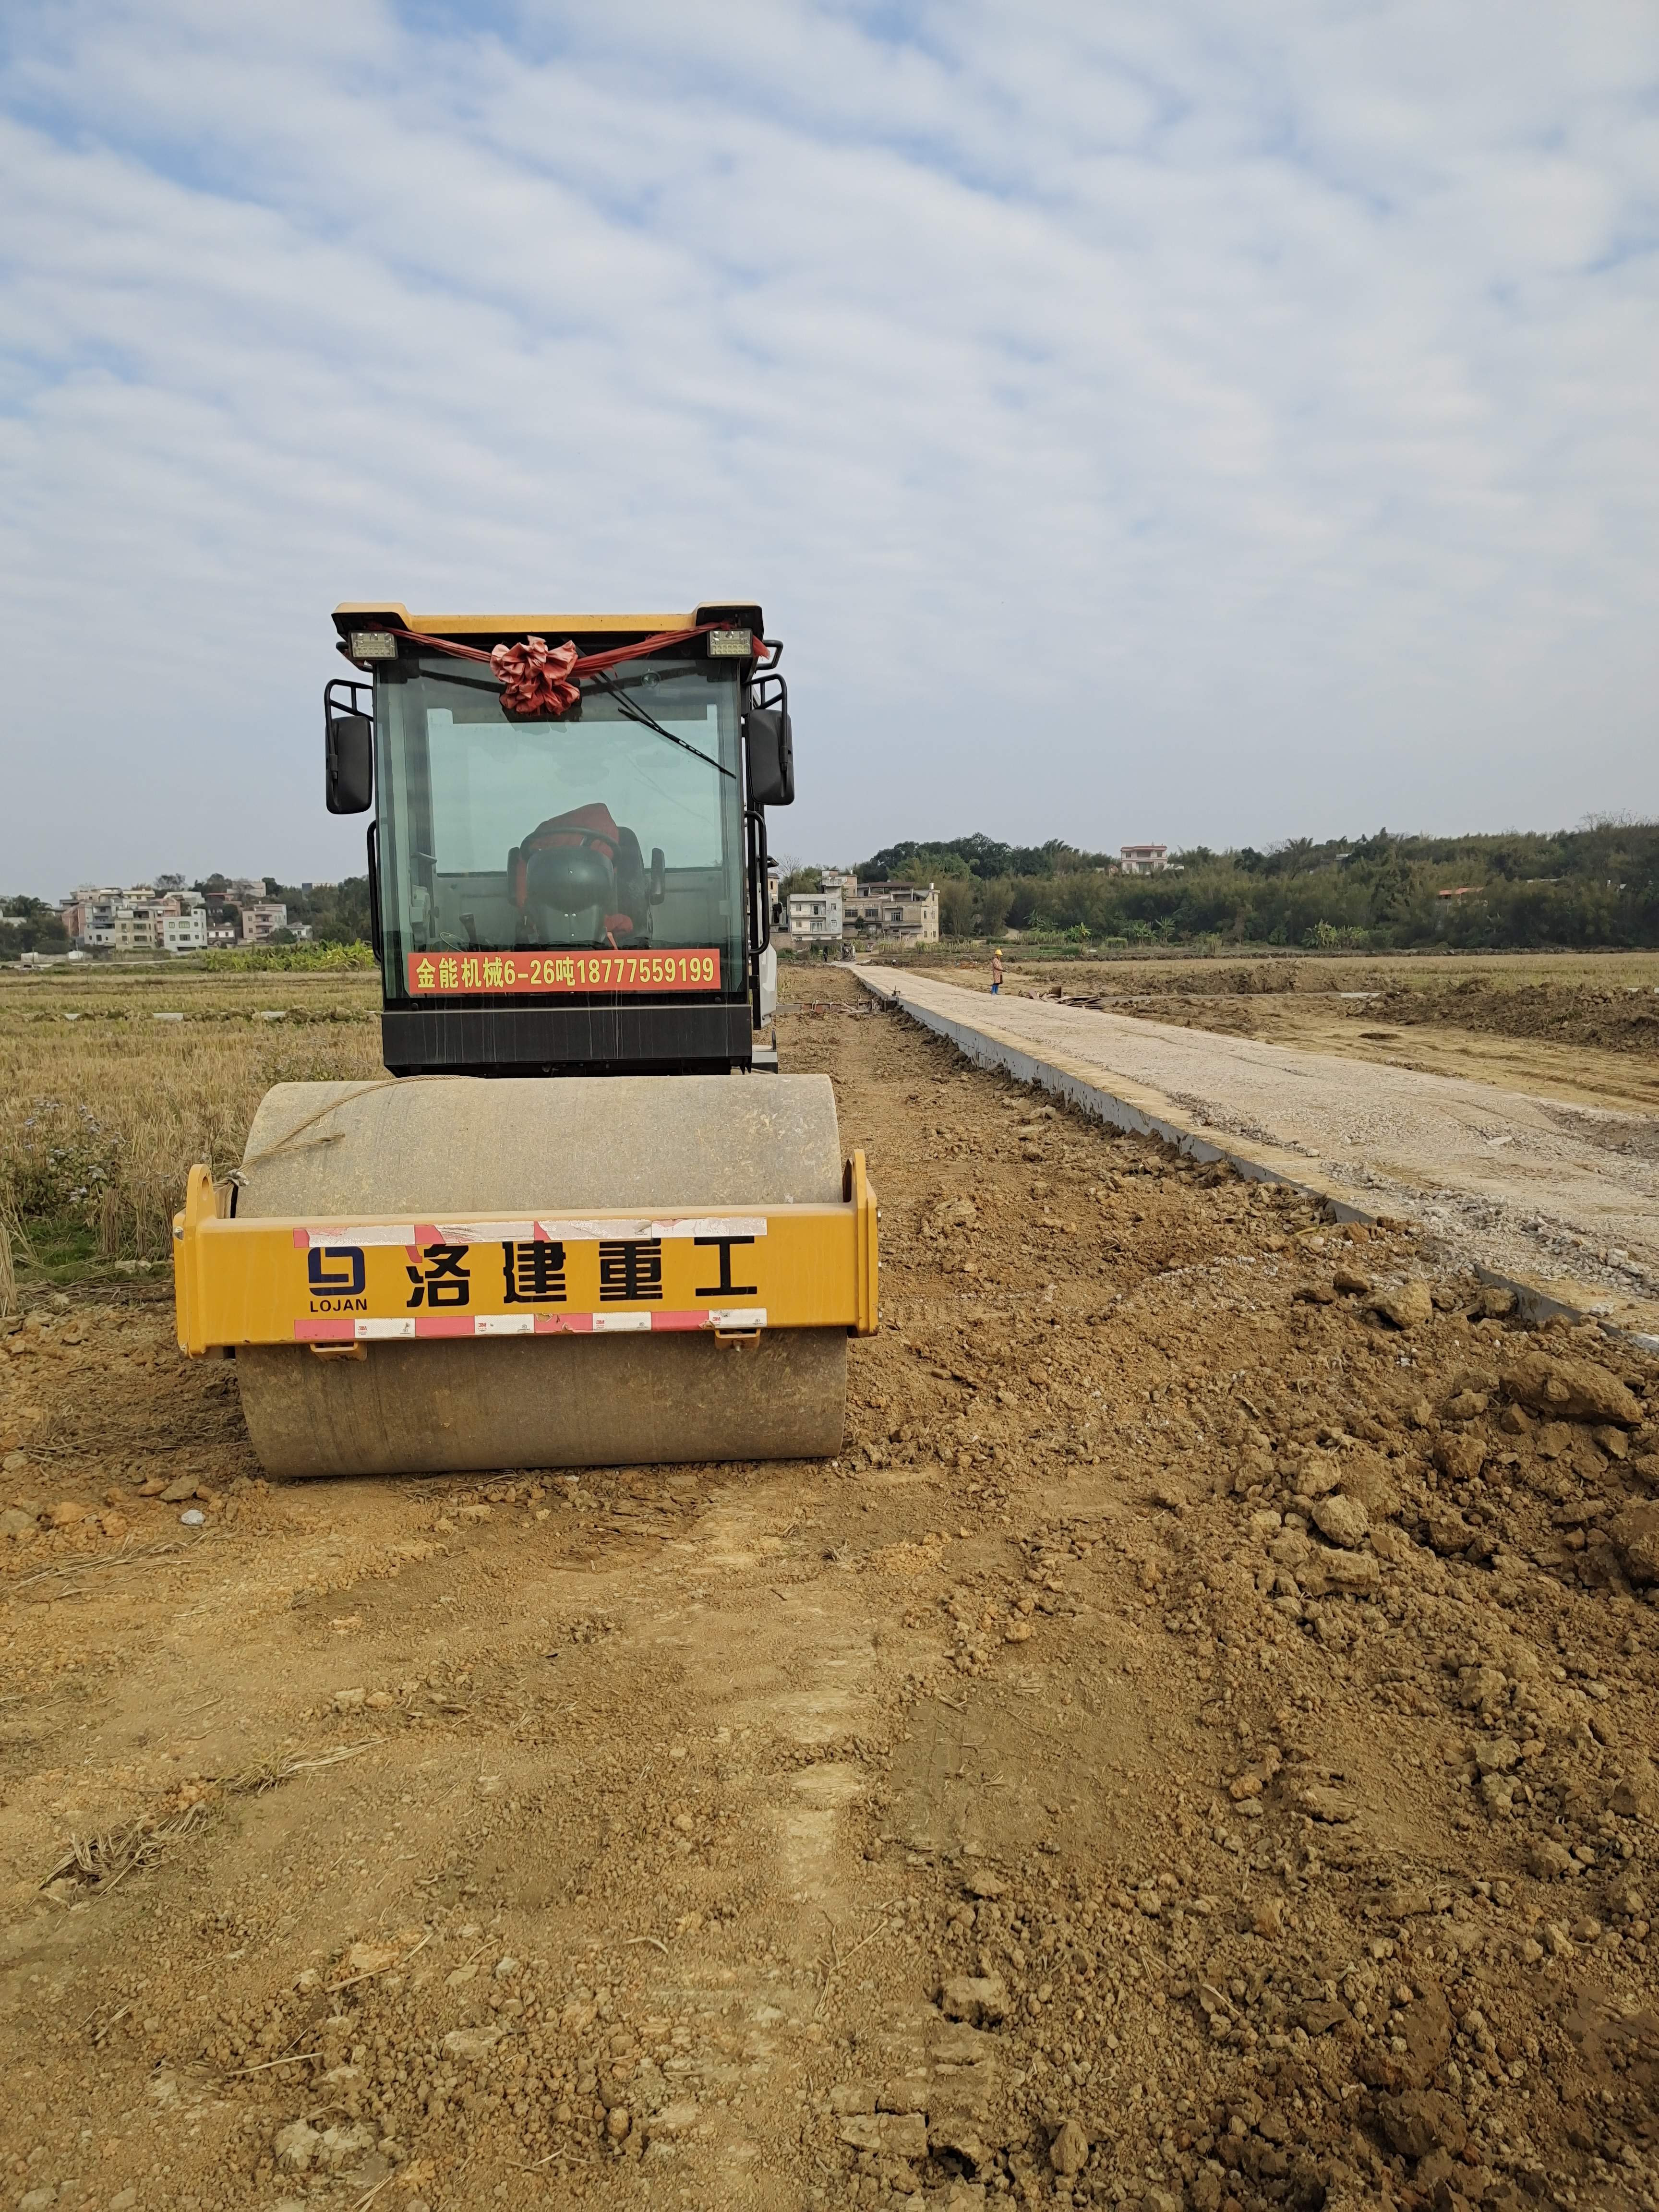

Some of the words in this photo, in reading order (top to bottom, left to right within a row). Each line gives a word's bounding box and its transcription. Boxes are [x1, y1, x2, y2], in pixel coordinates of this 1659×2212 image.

[416, 956, 714, 989] 金能机械6-26吨18777559199
[405, 1236, 757, 1308] 洛建重工
[310, 1298, 367, 1312] LOJAN
